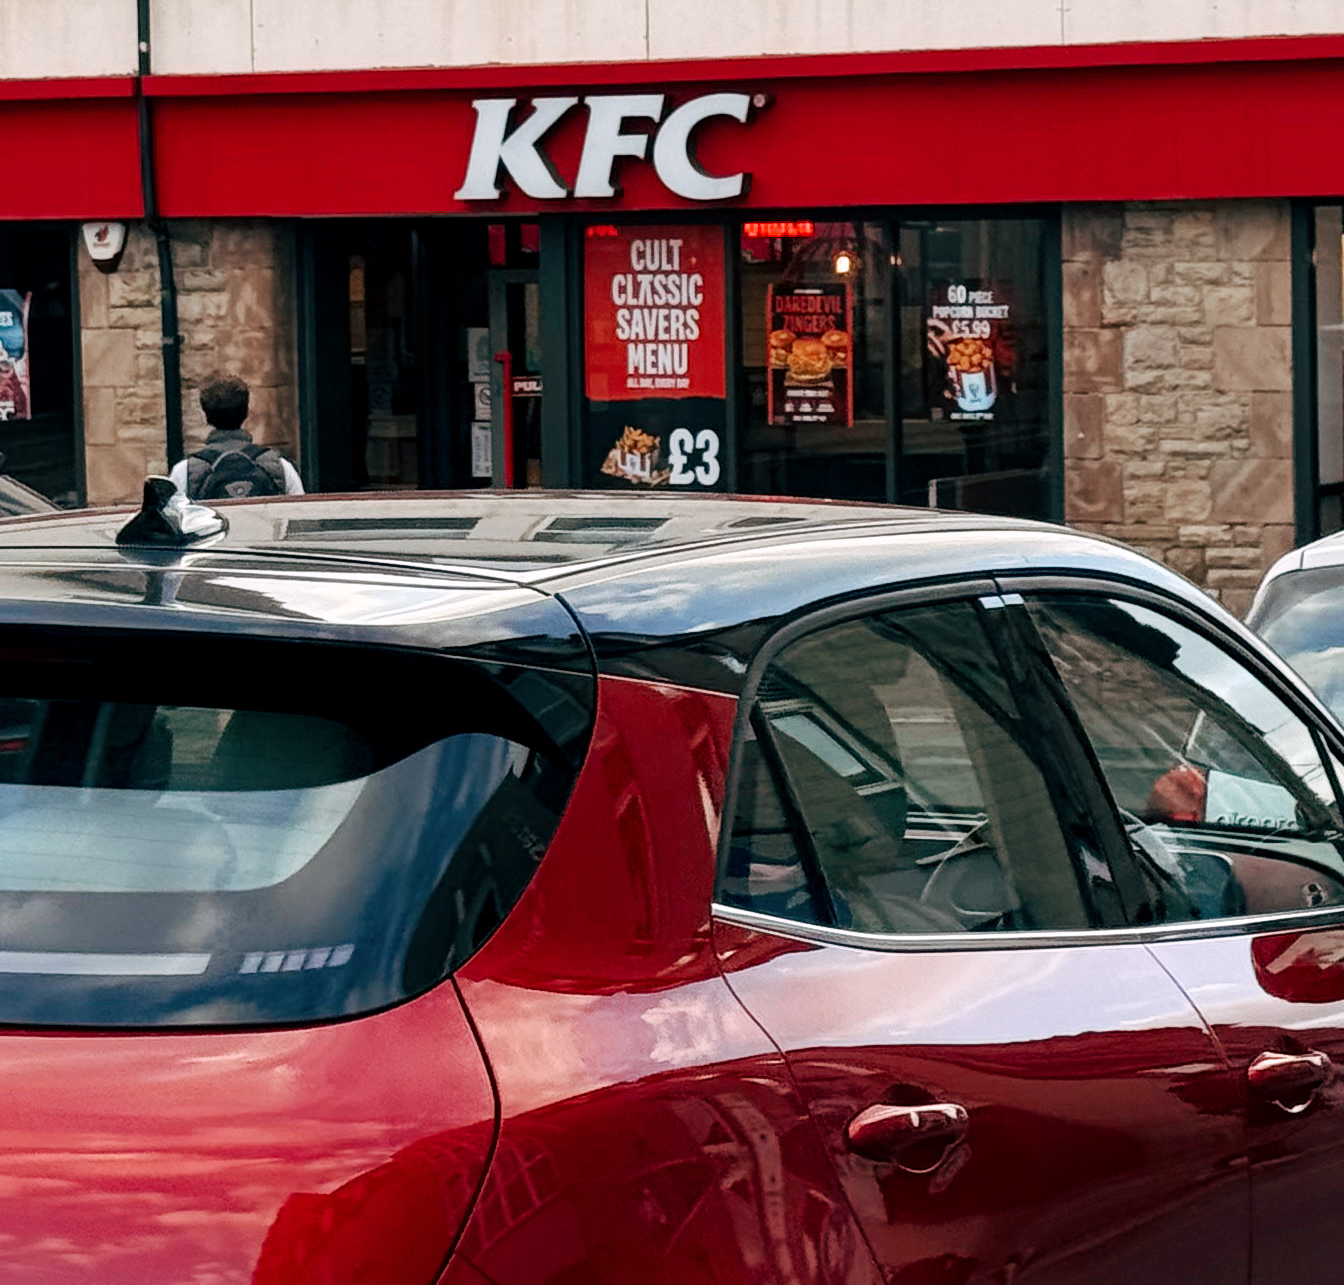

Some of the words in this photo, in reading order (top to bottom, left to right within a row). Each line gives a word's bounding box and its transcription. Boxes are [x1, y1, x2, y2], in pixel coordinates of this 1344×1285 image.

[454, 93, 751, 201] KFC
[630, 239, 683, 271] CULT
[612, 274, 704, 306] CLASSIC
[775, 296, 842, 314] DAREDEVIL
[948, 285, 966, 304] 60
[968, 290, 993, 304] PIECE
[616, 308, 700, 341] SAVERS
[784, 314, 836, 333] ZINGERS
[932, 305, 973, 319] POPCORN
[975, 305, 1009, 319] BUCKET
[627, 343, 688, 375] MENU
[514, 381, 543, 392] PUL
[668, 428, 720, 486] £3
